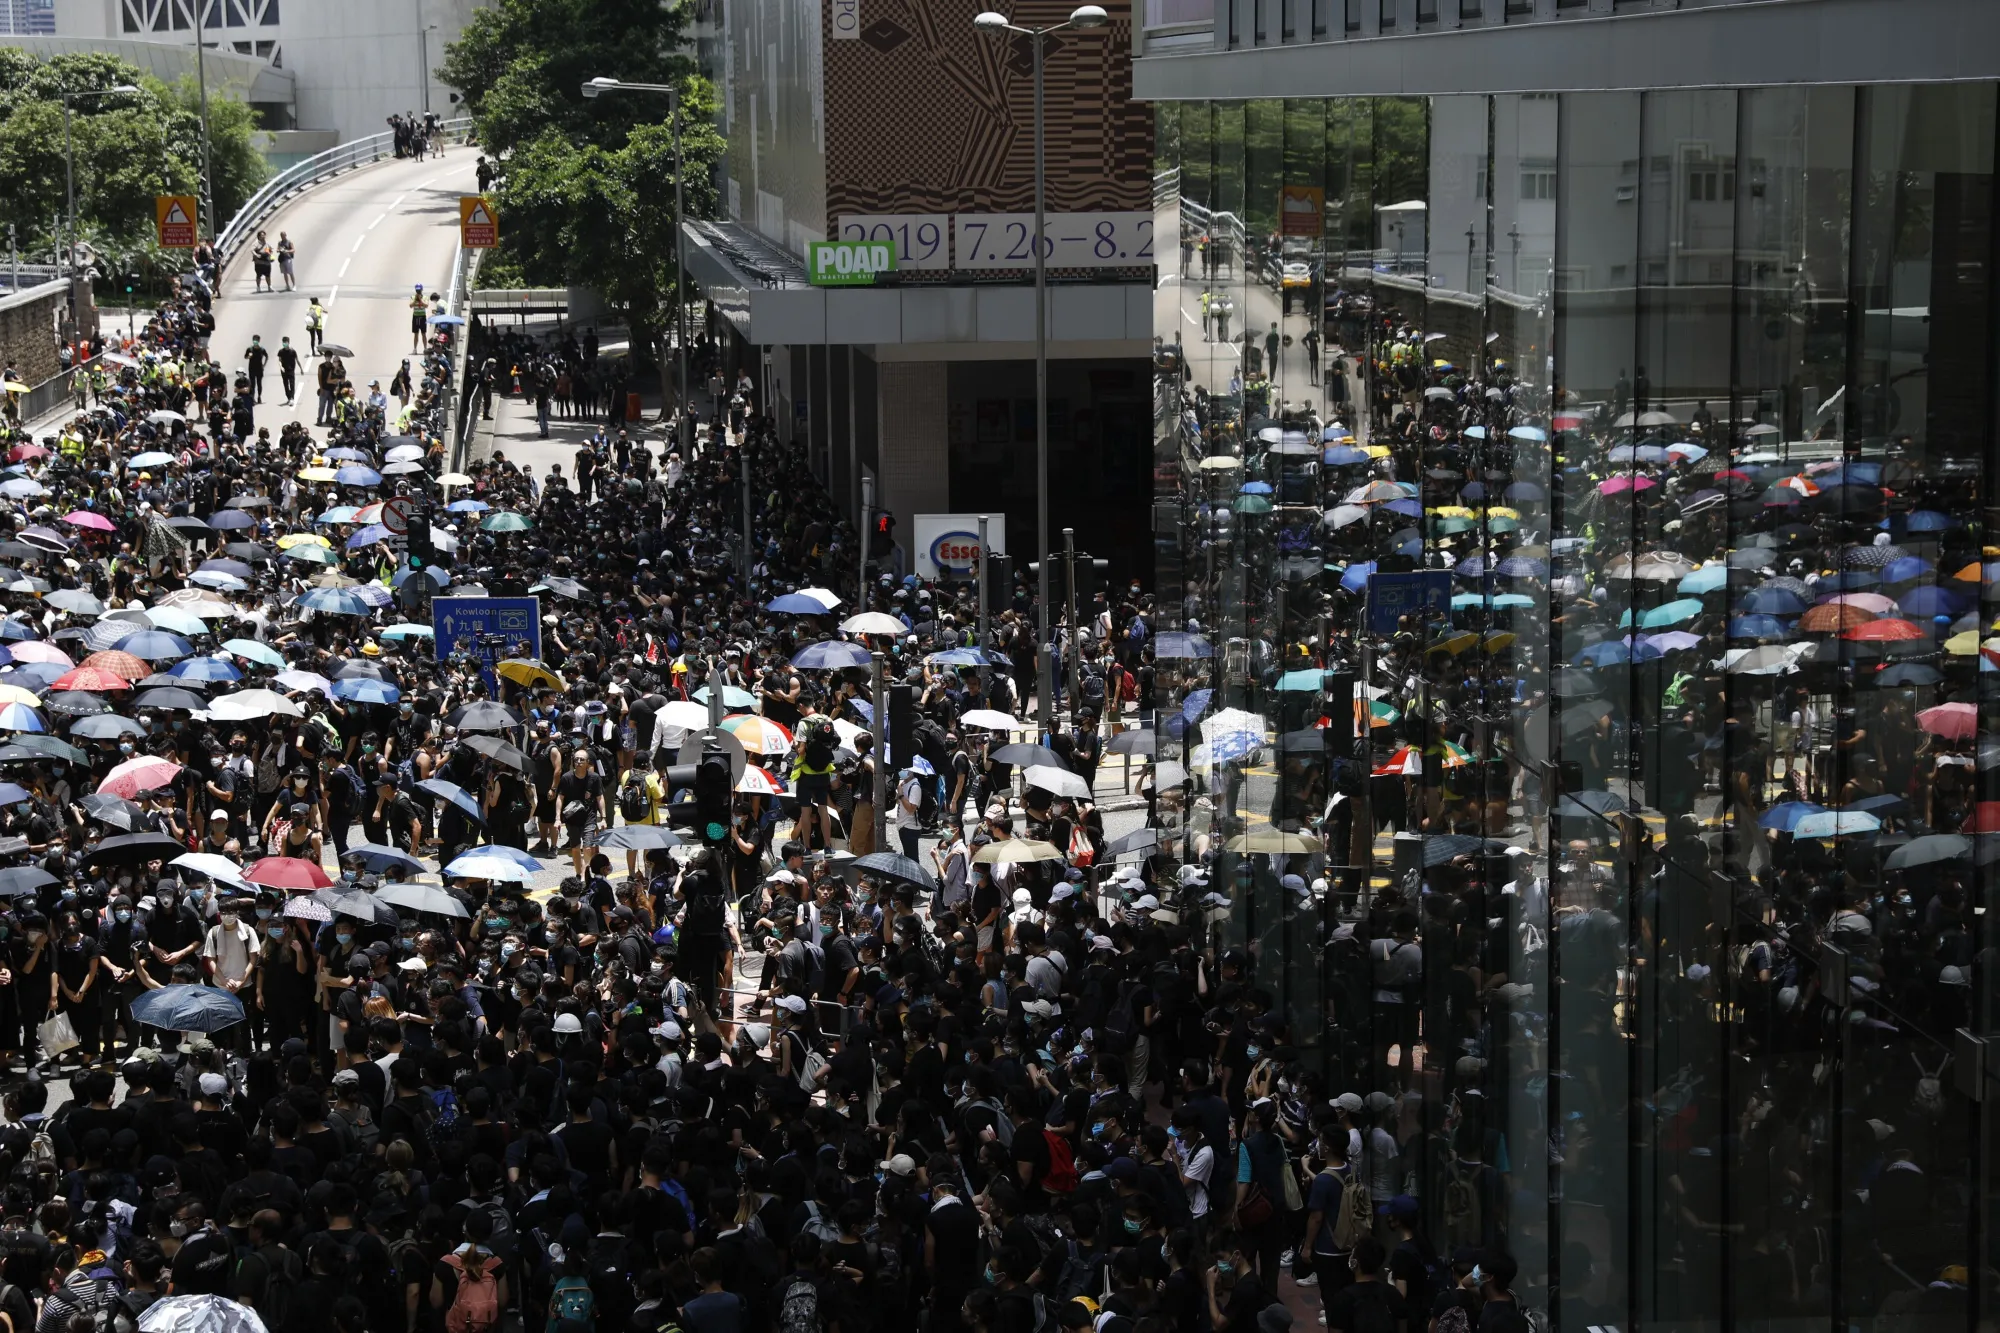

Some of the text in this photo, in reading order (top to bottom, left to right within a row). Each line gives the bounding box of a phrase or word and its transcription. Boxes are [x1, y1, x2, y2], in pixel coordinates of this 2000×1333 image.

[816, 245, 889, 273] POAD
[940, 543, 981, 560] Esso
[455, 607, 497, 616] Kowloon
[458, 620, 483, 631] 九龍
